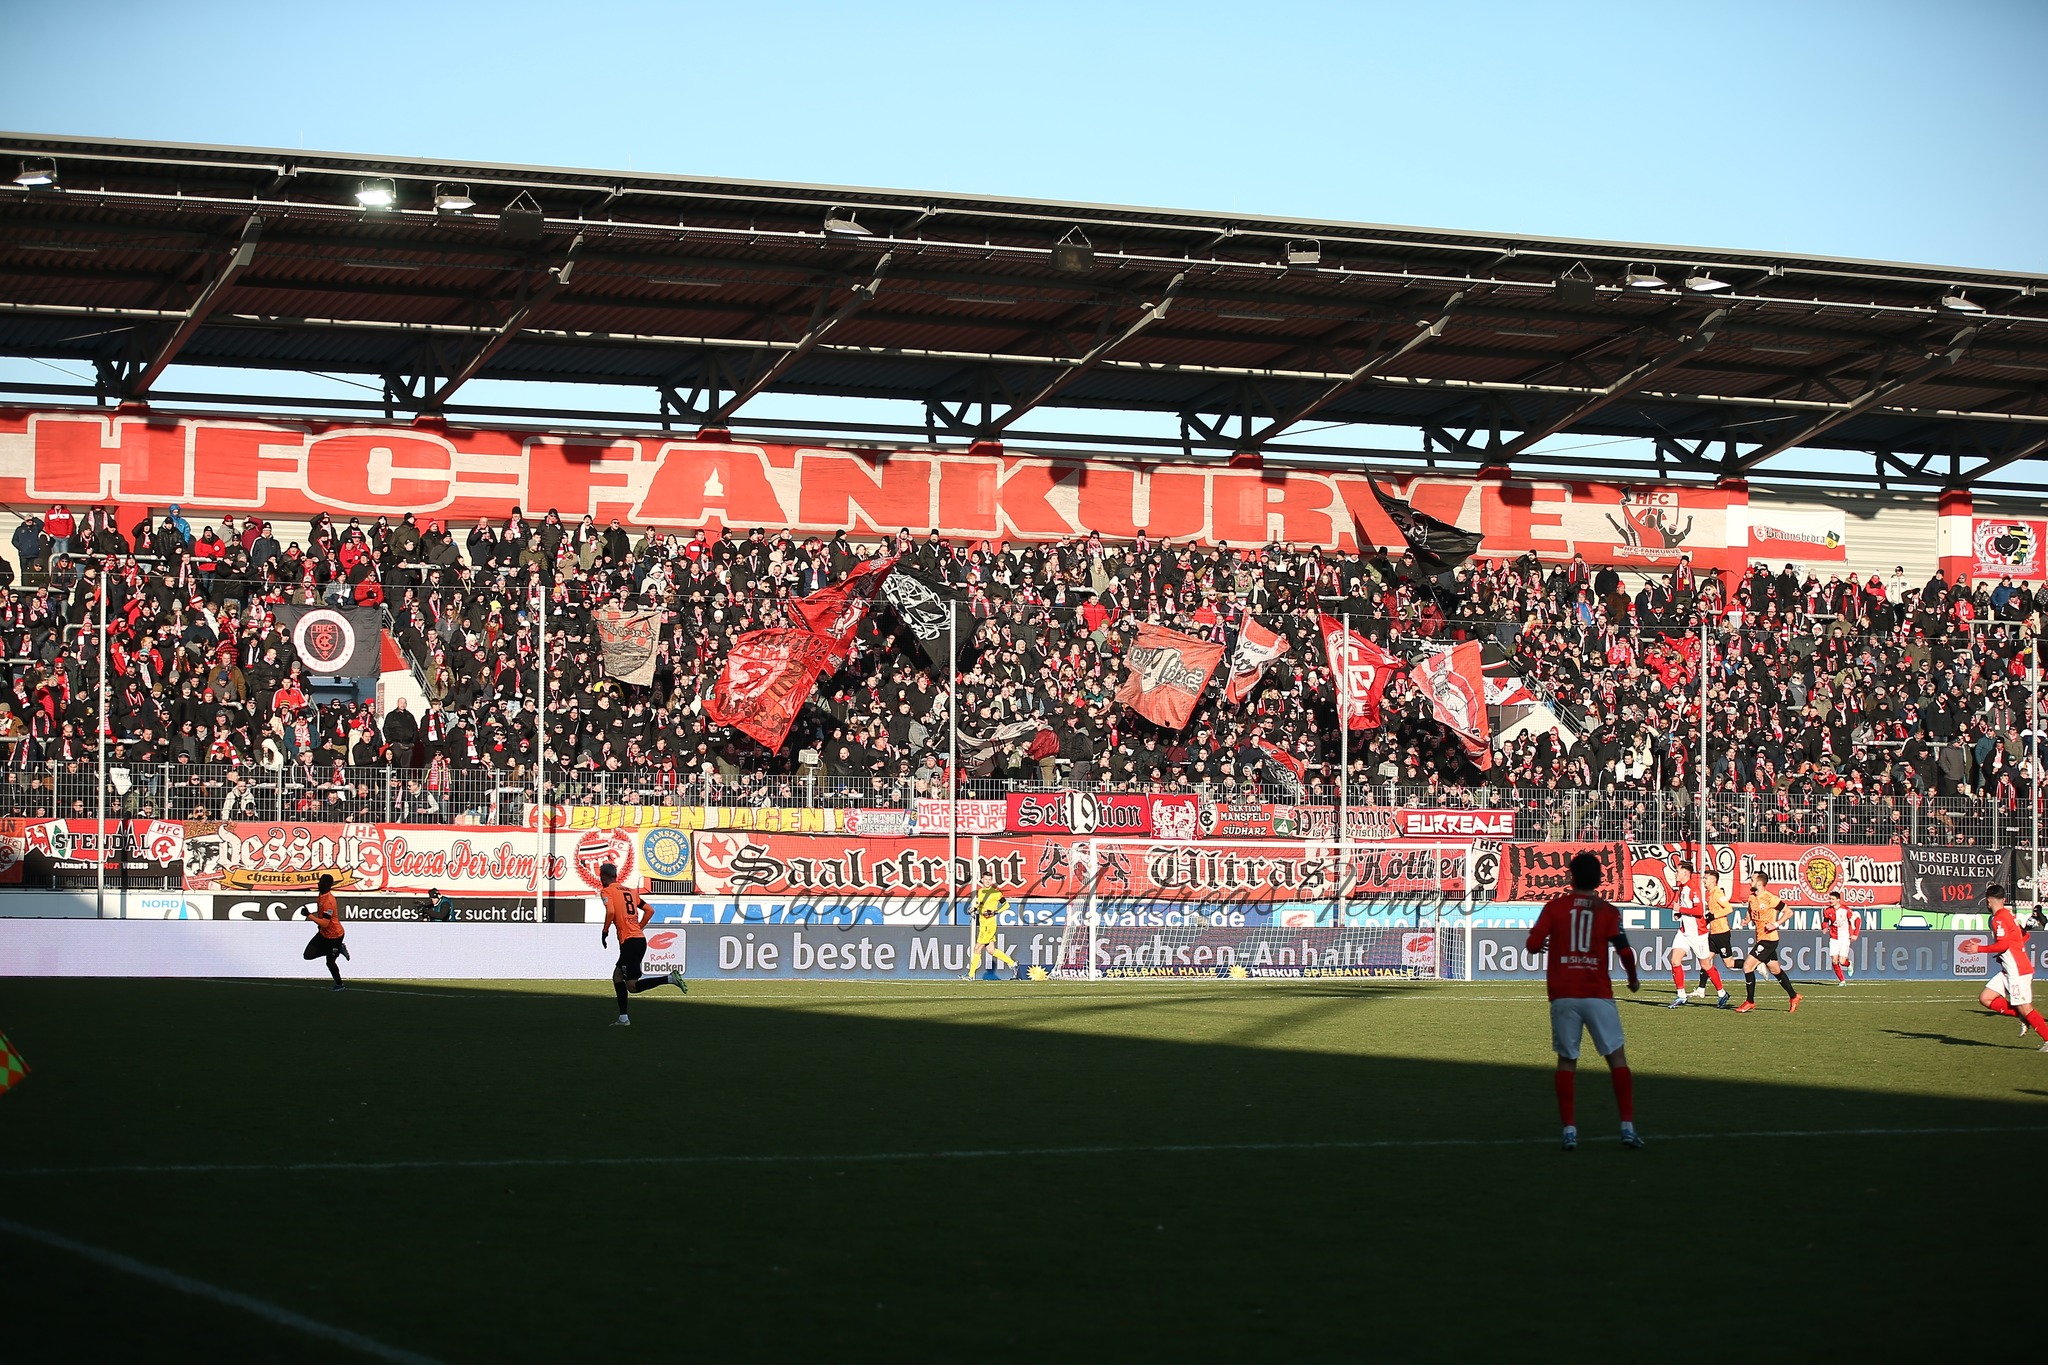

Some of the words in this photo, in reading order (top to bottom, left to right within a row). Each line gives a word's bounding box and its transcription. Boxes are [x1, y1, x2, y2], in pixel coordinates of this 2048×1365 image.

[1636, 493, 1669, 505] HFC
[1766, 526, 1825, 544] Braunsbedra
[1984, 526, 2003, 535] HFC
[1624, 546, 1681, 554] HFC-FANKURVE
[1228, 804, 1262, 812] SEKTION
[570, 805, 705, 832] BULLEN
[1220, 812, 1271, 822] MANSFELD
[1407, 814, 1513, 834] SURREALE
[157, 824, 181, 836] HFC
[1222, 823, 1267, 836] SÜDHARZ
[1330, 827, 1391, 838] Ledenschaft
[3, 836, 18, 847] HFC
[55, 833, 151, 851] STENDAL
[648, 830, 688, 850] FANSZENE
[646, 847, 687, 873] LOKOMOTIVE
[1801, 849, 1840, 866] HALLESCHER
[1909, 850, 2003, 865] MERSEBURGER
[53, 862, 88, 870] Altmark
[104, 862, 119, 870] ROT
[122, 862, 149, 870] WEISS
[448, 840, 490, 879] Per
[490, 842, 567, 891] Sempre
[730, 844, 1027, 890] Saalefront
[1146, 846, 1326, 891] Ultras
[1741, 854, 1798, 882] Leuna
[1846, 855, 1902, 884] Löwen
[1917, 864, 1995, 878] DOMFALKEN
[247, 871, 292, 884] chemie
[1779, 887, 1801, 901] seit
[1843, 887, 1874, 903] 1984
[1940, 883, 1975, 902] 1982
[142, 900, 179, 908] NORD
[623, 892, 635, 915] 8
[466, 906, 507, 920] sucht
[1569, 908, 1593, 952] 10
[650, 952, 675, 961] Radio
[719, 932, 779, 970] Die
[793, 932, 895, 971] beste
[1030, 933, 1083, 965] für
[643, 962, 684, 972] Brocken
[1959, 957, 1980, 965] Radio
[1106, 968, 1175, 978] SPIELBANK
[1178, 967, 1217, 977] HALLE
[1252, 968, 1300, 978] MERKUR
[1304, 968, 1370, 978] SPIELBANK
[1375, 968, 1414, 978] HALLE
[1955, 964, 1986, 974] Brocken
